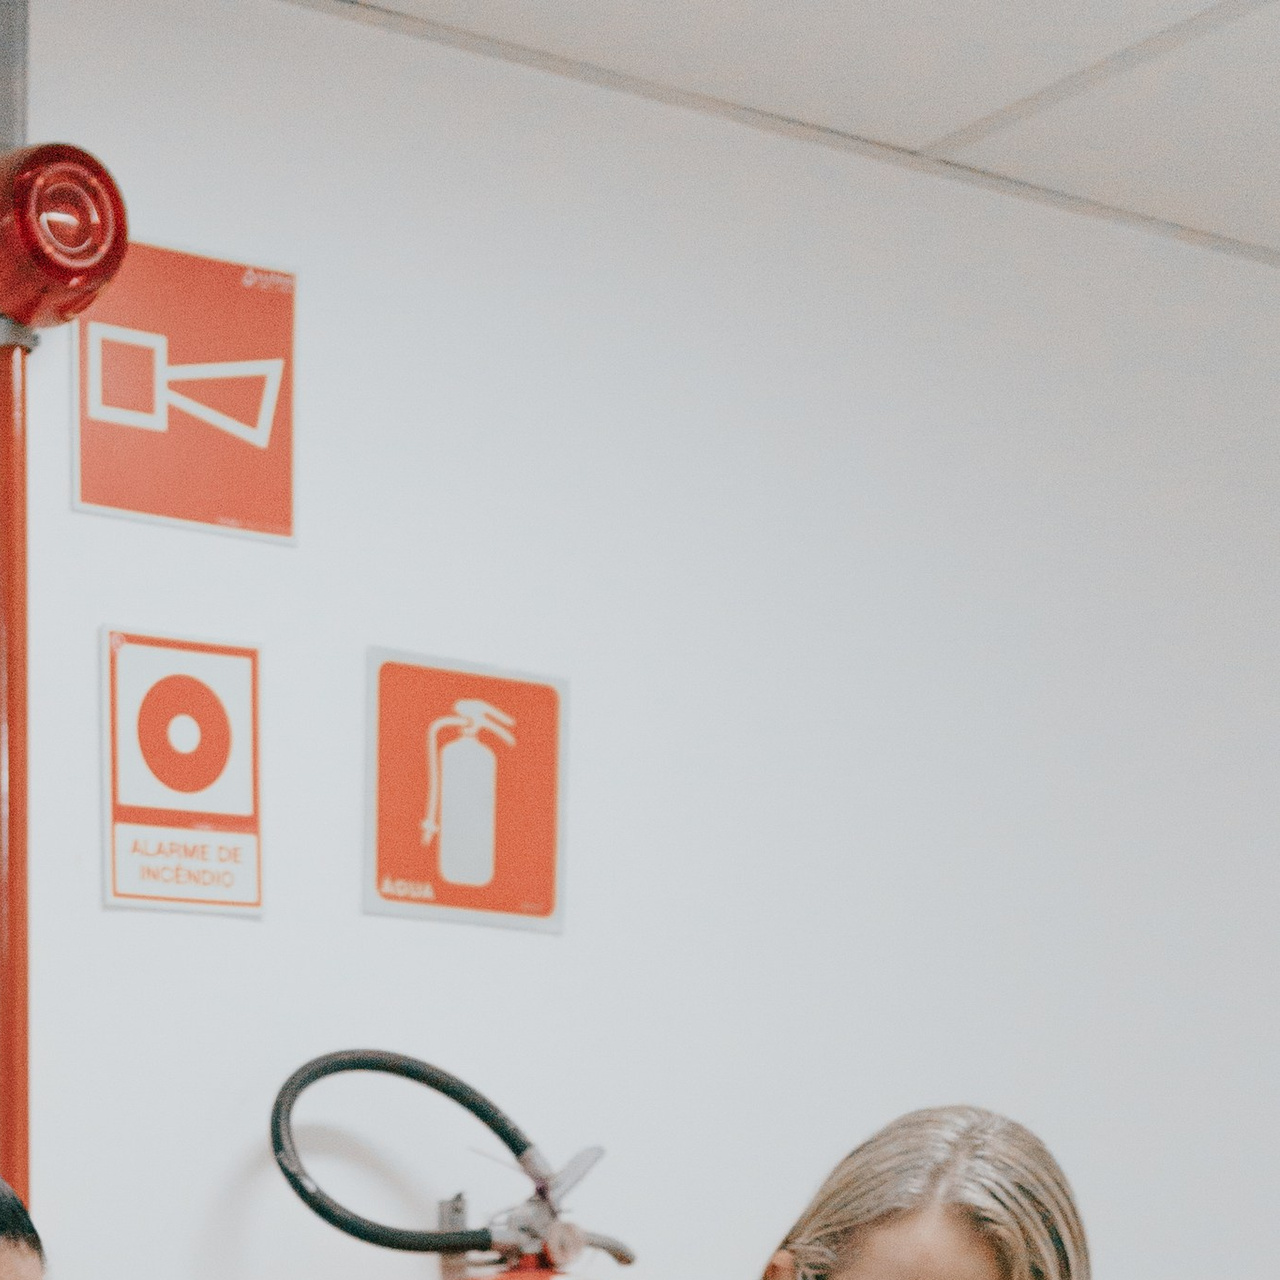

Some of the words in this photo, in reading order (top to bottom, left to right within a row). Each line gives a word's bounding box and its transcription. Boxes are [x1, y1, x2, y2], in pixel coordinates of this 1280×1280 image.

[130, 839, 210, 862] ALARME
[217, 845, 242, 864] DE
[139, 865, 235, 888] INCÊNDIO
